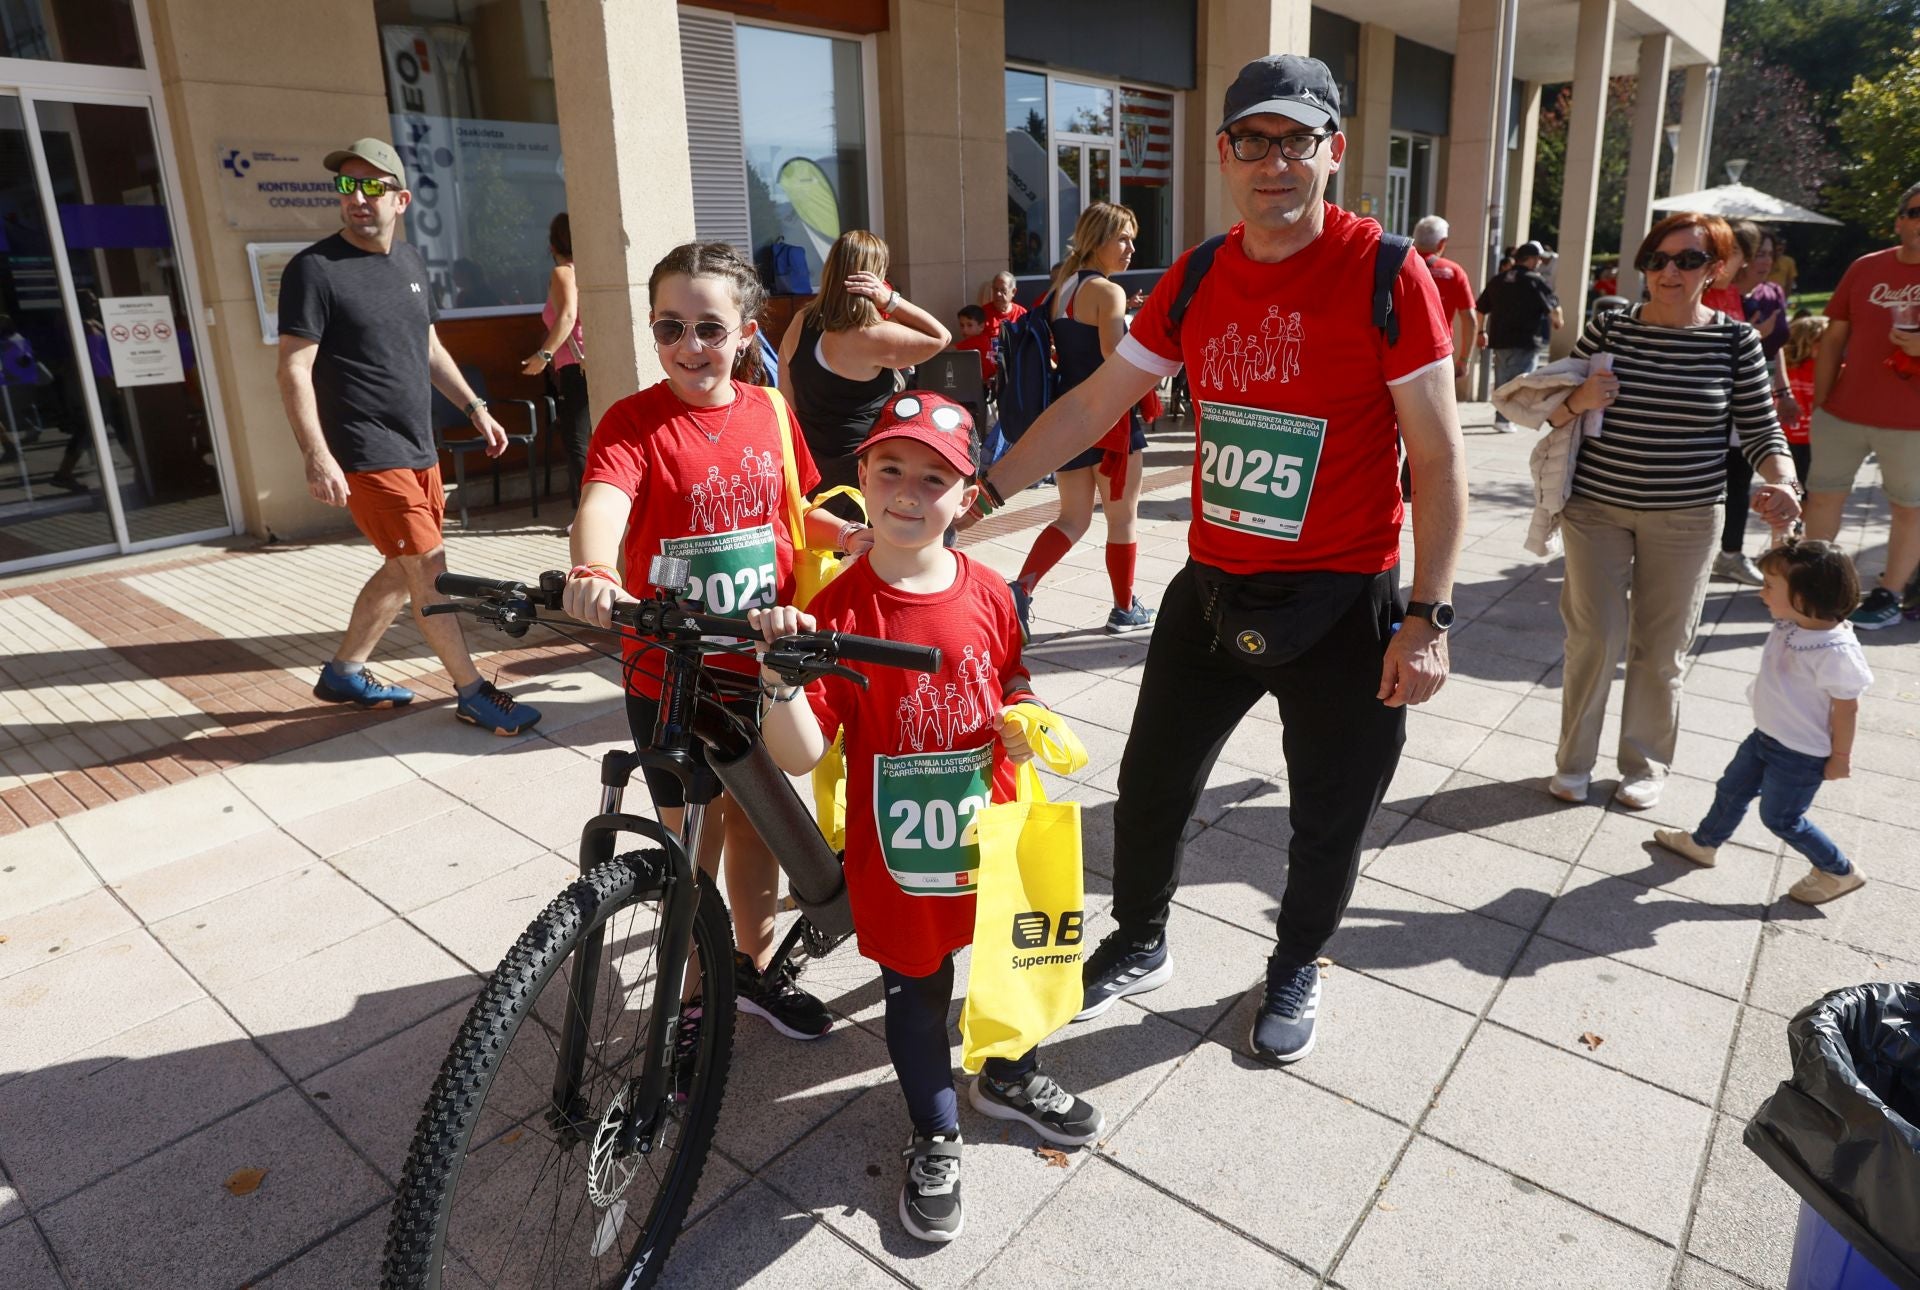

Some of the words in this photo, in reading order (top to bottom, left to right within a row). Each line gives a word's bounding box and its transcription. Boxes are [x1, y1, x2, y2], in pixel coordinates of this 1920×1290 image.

[257, 182, 336, 192] KONTSULTATE
[268, 197, 341, 208] CONSULTORI
[1222, 409, 1243, 418] FAMILIA
[1243, 412, 1282, 425] LASTERKETA
[1228, 417, 1257, 428] FAMILIAR
[1257, 421, 1292, 433] SOLIDARIA
[1292, 427, 1302, 435] DE
[1302, 429, 1319, 438] LOIU
[1202, 440, 1304, 499] 2025
[675, 549, 704, 557] CARRERA
[704, 544, 734, 554] FAMILIAR
[695, 540, 719, 548] FAMILIA
[687, 563, 777, 615] 2025
[914, 759, 940, 767] FAMILIA
[940, 754, 982, 766] LASTERKETA
[889, 767, 924, 778] CARRERA
[924, 764, 958, 775] FAMILIAR
[1055, 911, 1084, 946] B
[1012, 951, 1083, 970] Supermerc
